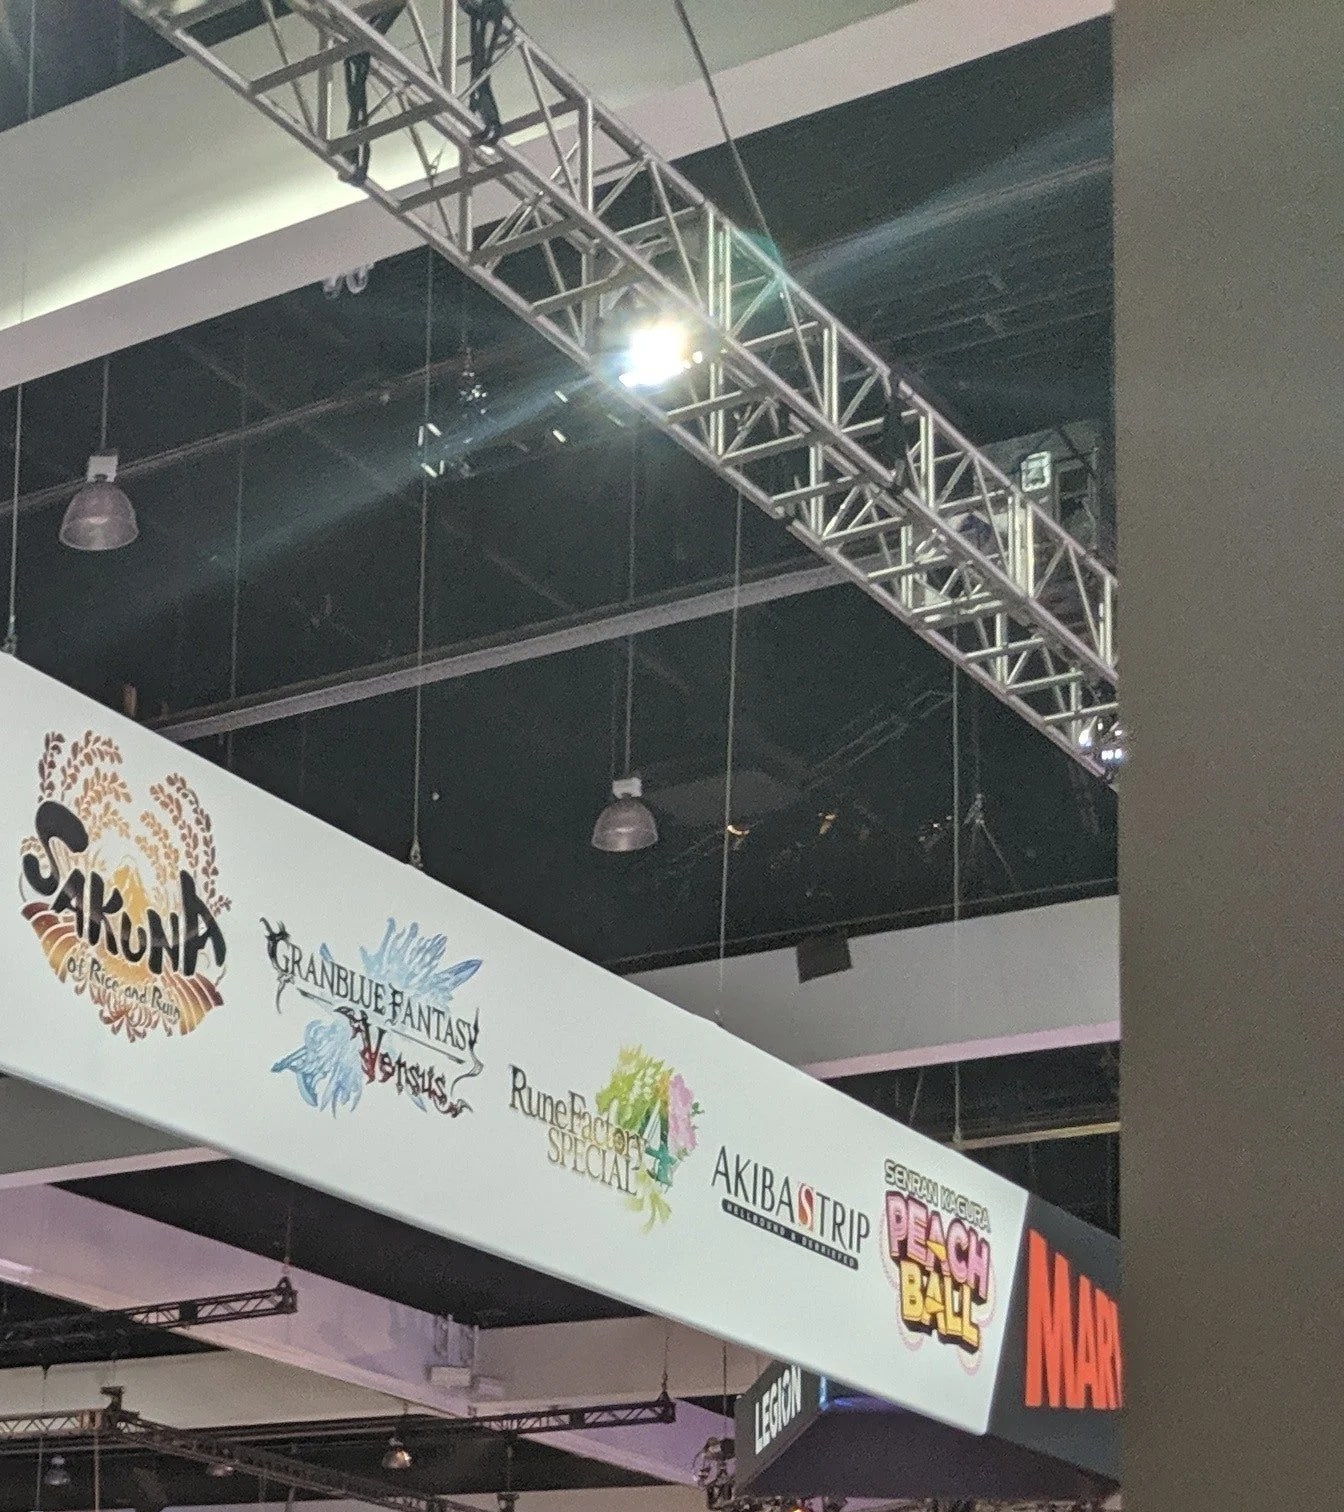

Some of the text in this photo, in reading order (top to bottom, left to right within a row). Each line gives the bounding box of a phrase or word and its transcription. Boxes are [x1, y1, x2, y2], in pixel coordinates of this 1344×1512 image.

[22, 800, 227, 976] SAKUNA
[67, 955, 180, 1018] of Rice and Ruin
[267, 925, 472, 1050] GRANBLUE FANTASY
[546, 1124, 639, 1197] SPECIAL
[884, 1159, 992, 1233] SENRAN KAGURA
[886, 1191, 991, 1304] PEACH
[900, 1259, 980, 1352] BALL
[754, 1364, 803, 1455] LEGION
